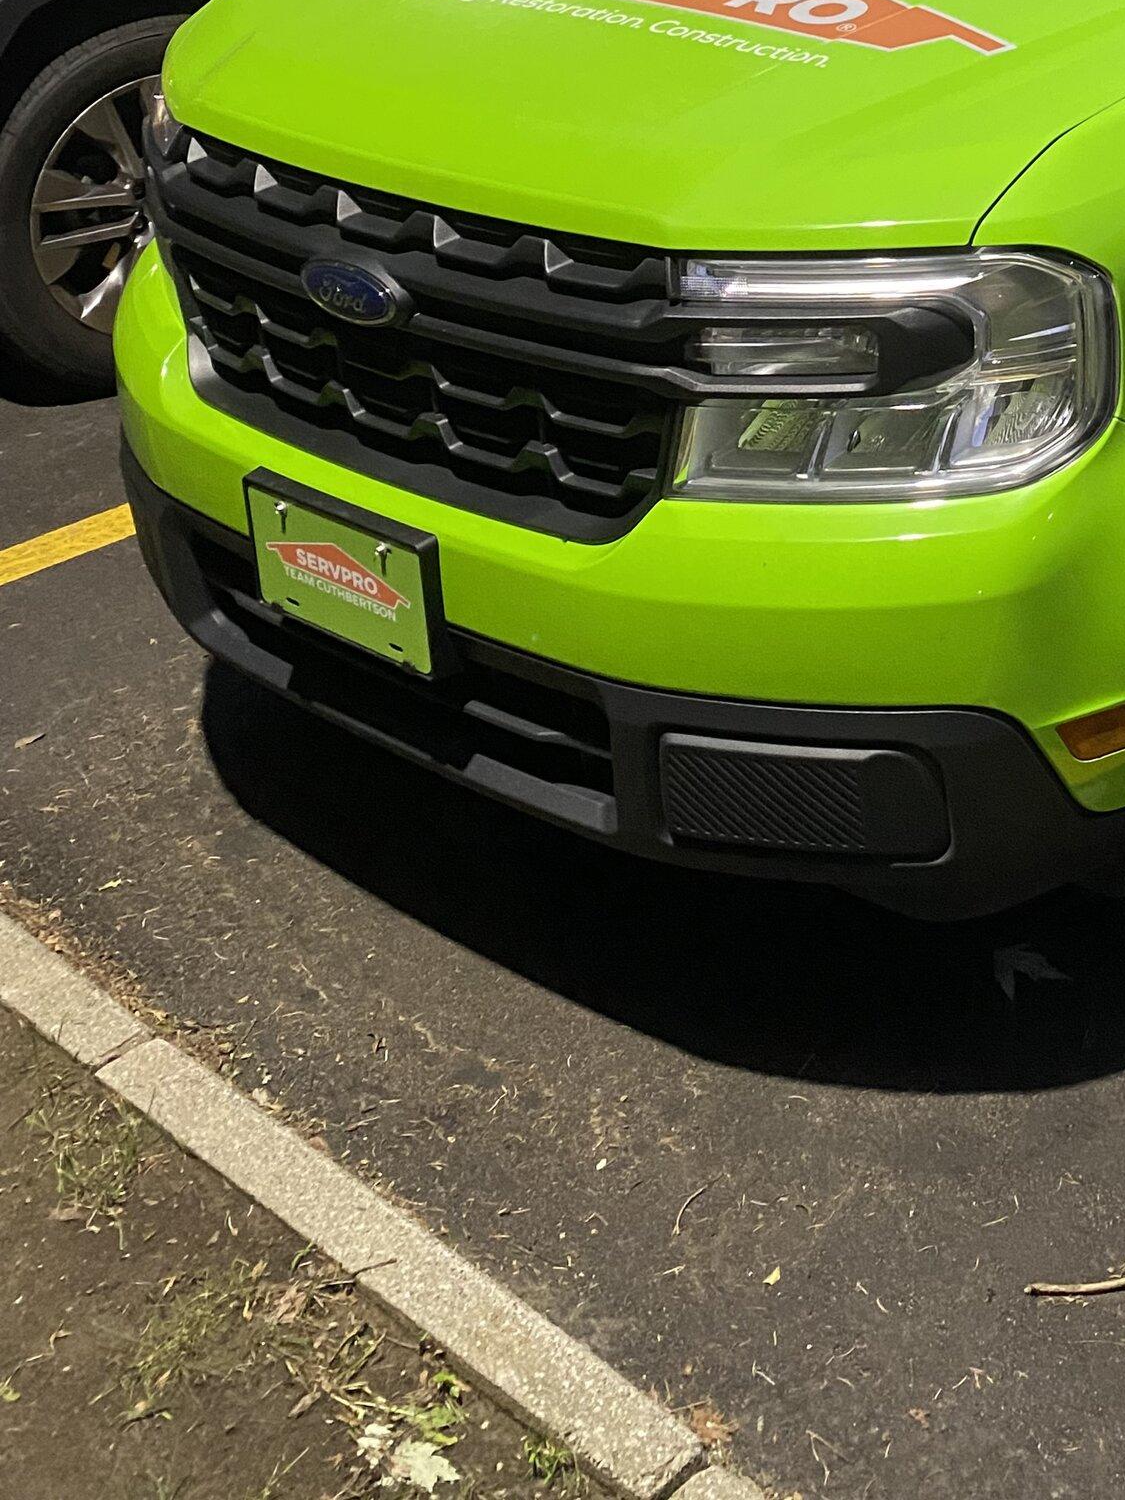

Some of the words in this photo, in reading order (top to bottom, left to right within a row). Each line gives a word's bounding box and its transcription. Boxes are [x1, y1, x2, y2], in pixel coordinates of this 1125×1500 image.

[649, 19, 830, 69] Construction.
[283, 564, 316, 589] TEAM
[316, 579, 397, 622] CUTHBERTSON
[296, 547, 379, 596] SERVPRO
